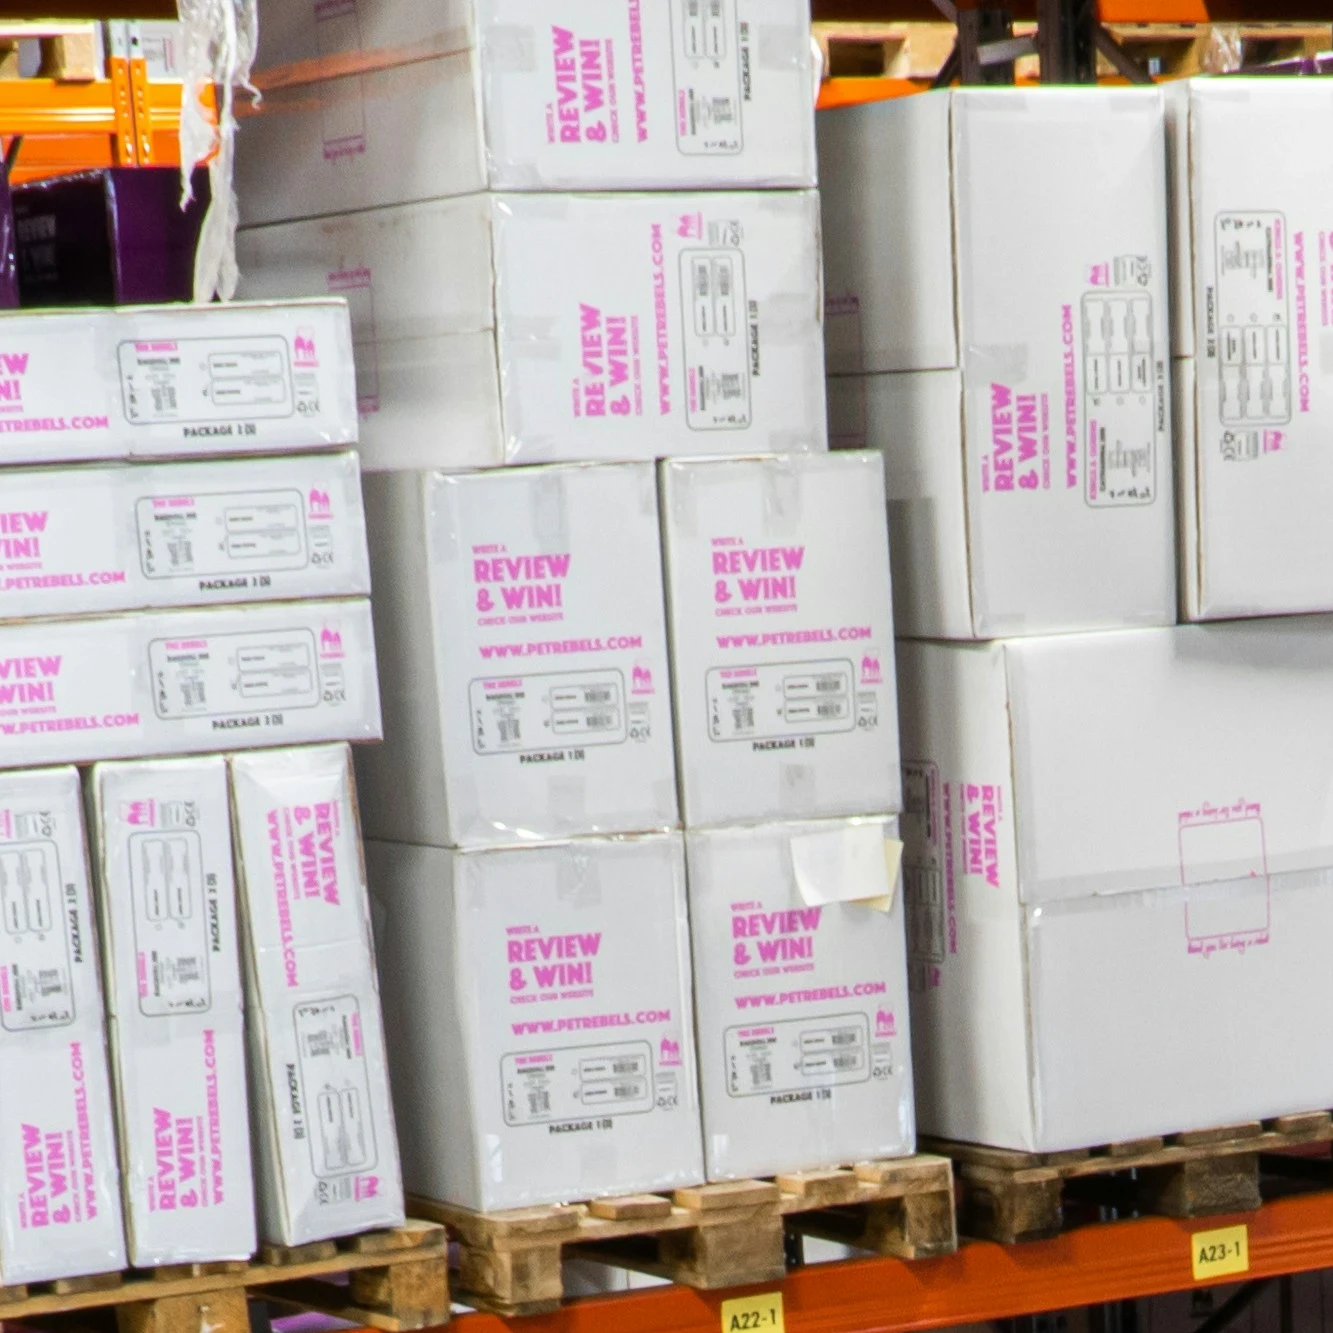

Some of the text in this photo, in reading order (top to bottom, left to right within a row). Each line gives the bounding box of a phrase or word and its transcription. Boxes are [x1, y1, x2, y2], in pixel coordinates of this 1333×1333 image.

[553, 26, 581, 143] REVIEW
[580, 40, 606, 142] & WIN!
[607, 317, 631, 416] & WIN!
[991, 383, 1014, 491] REVIEW
[1016, 395, 1039, 490] & WIN!
[474, 554, 570, 583] REVIEW
[712, 548, 804, 575] REVIEW
[476, 585, 561, 611] & WIN!
[715, 577, 795, 603] & WIN!
[479, 636, 643, 658] WWW.PETREBELS.COM
[716, 627, 872, 648] WWW.PETREBELS.COM
[0, 656, 61, 684] VIEW
[968, 815, 983, 874] WIN!
[981, 784, 1000, 887] REVIEW
[293, 807, 320, 898] & WIN!
[313, 802, 340, 905] REVIEW
[732, 905, 821, 938] REVIEW
[507, 933, 601, 962] REVIEW
[734, 937, 813, 965] & WIN!
[509, 963, 592, 991] & WIN!
[735, 982, 887, 1009] WWW.PETREBELS.COM
[511, 1010, 671, 1035] WWW.PETREBELS.COM
[20, 1123, 49, 1228] REVIEW
[154, 1108, 177, 1210] REVIEW
[176, 1118, 198, 1208] & WIN!
[45, 1133, 71, 1224] & WIN!
[1199, 1241, 1241, 1263] A23-1
